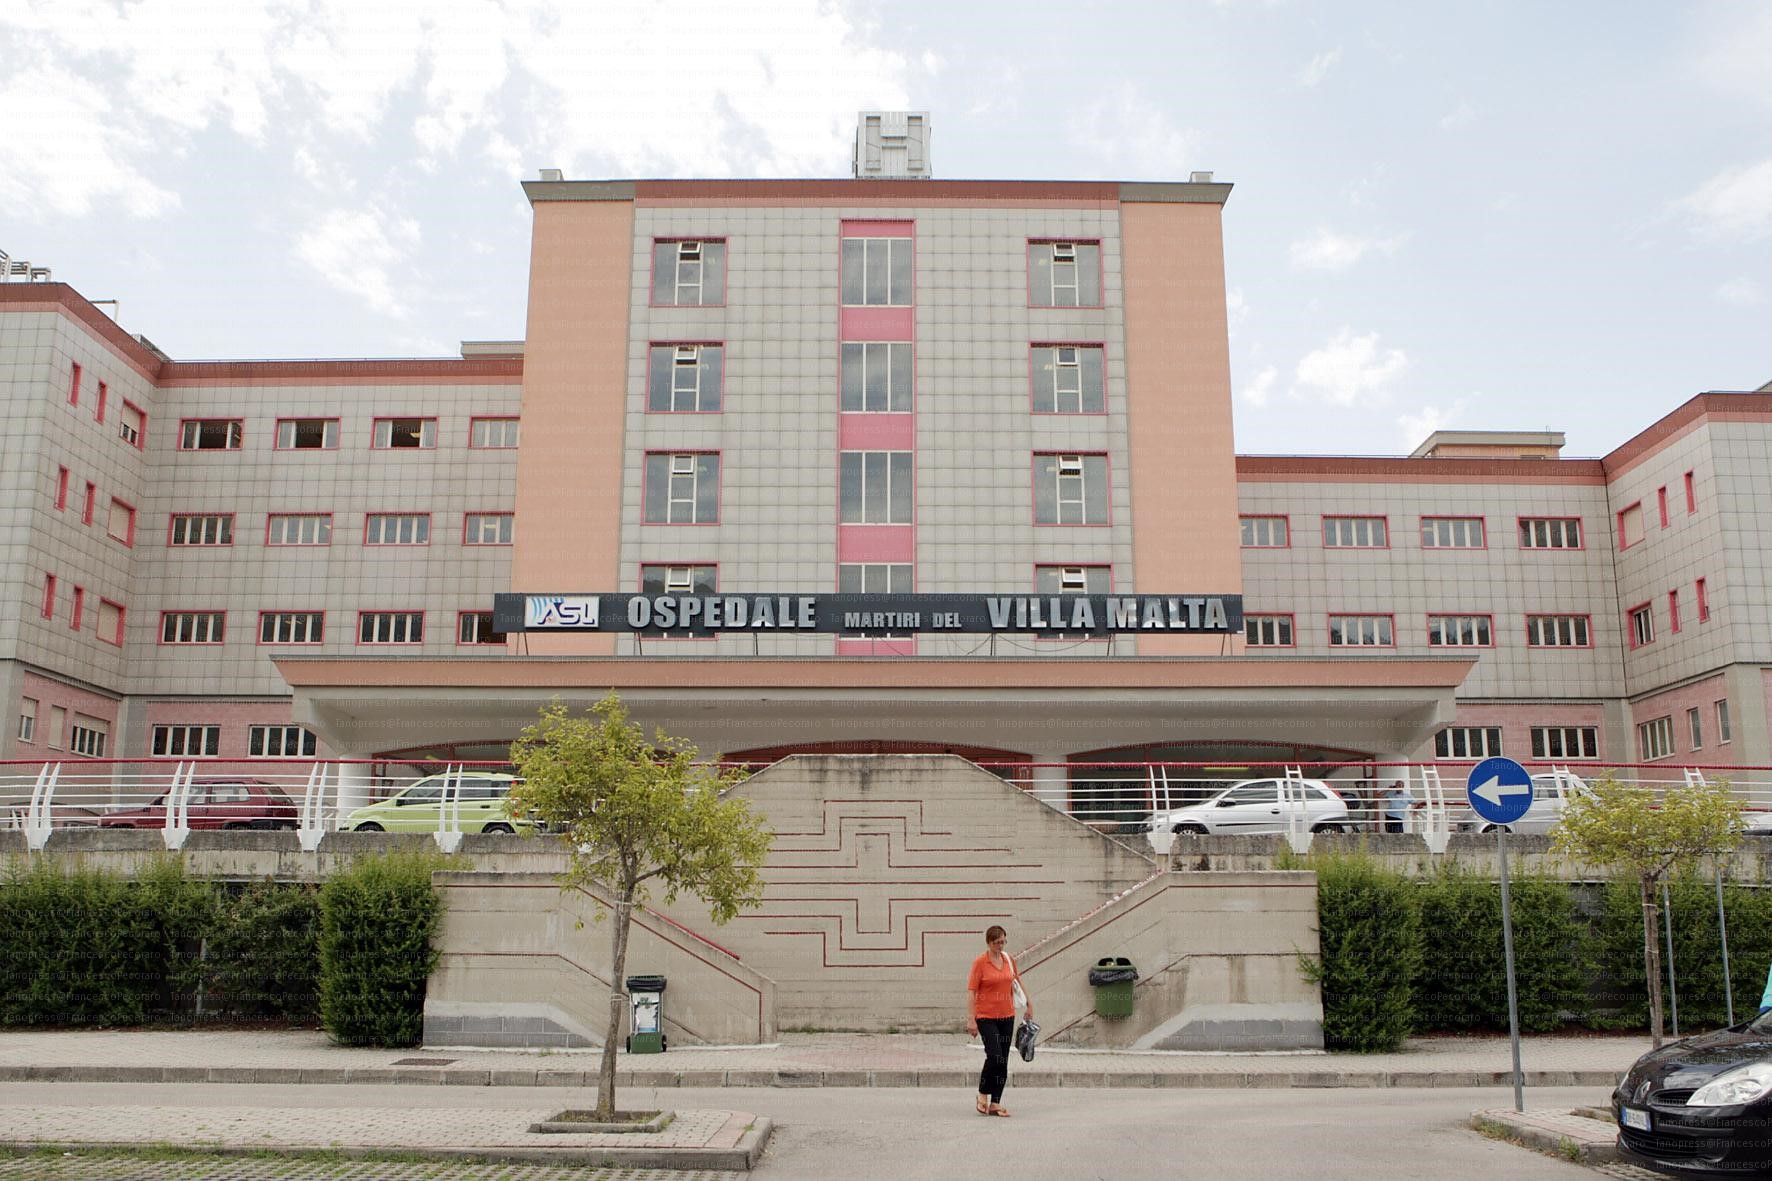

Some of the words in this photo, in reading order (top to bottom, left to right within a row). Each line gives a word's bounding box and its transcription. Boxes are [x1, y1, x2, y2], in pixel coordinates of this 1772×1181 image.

[536, 599, 596, 626] ASL
[628, 597, 816, 628] OSPEDALE
[844, 612, 920, 628] MARTIRI
[932, 612, 962, 628] DEL
[986, 597, 1096, 628] VILLA
[1106, 597, 1228, 628] MALTA
